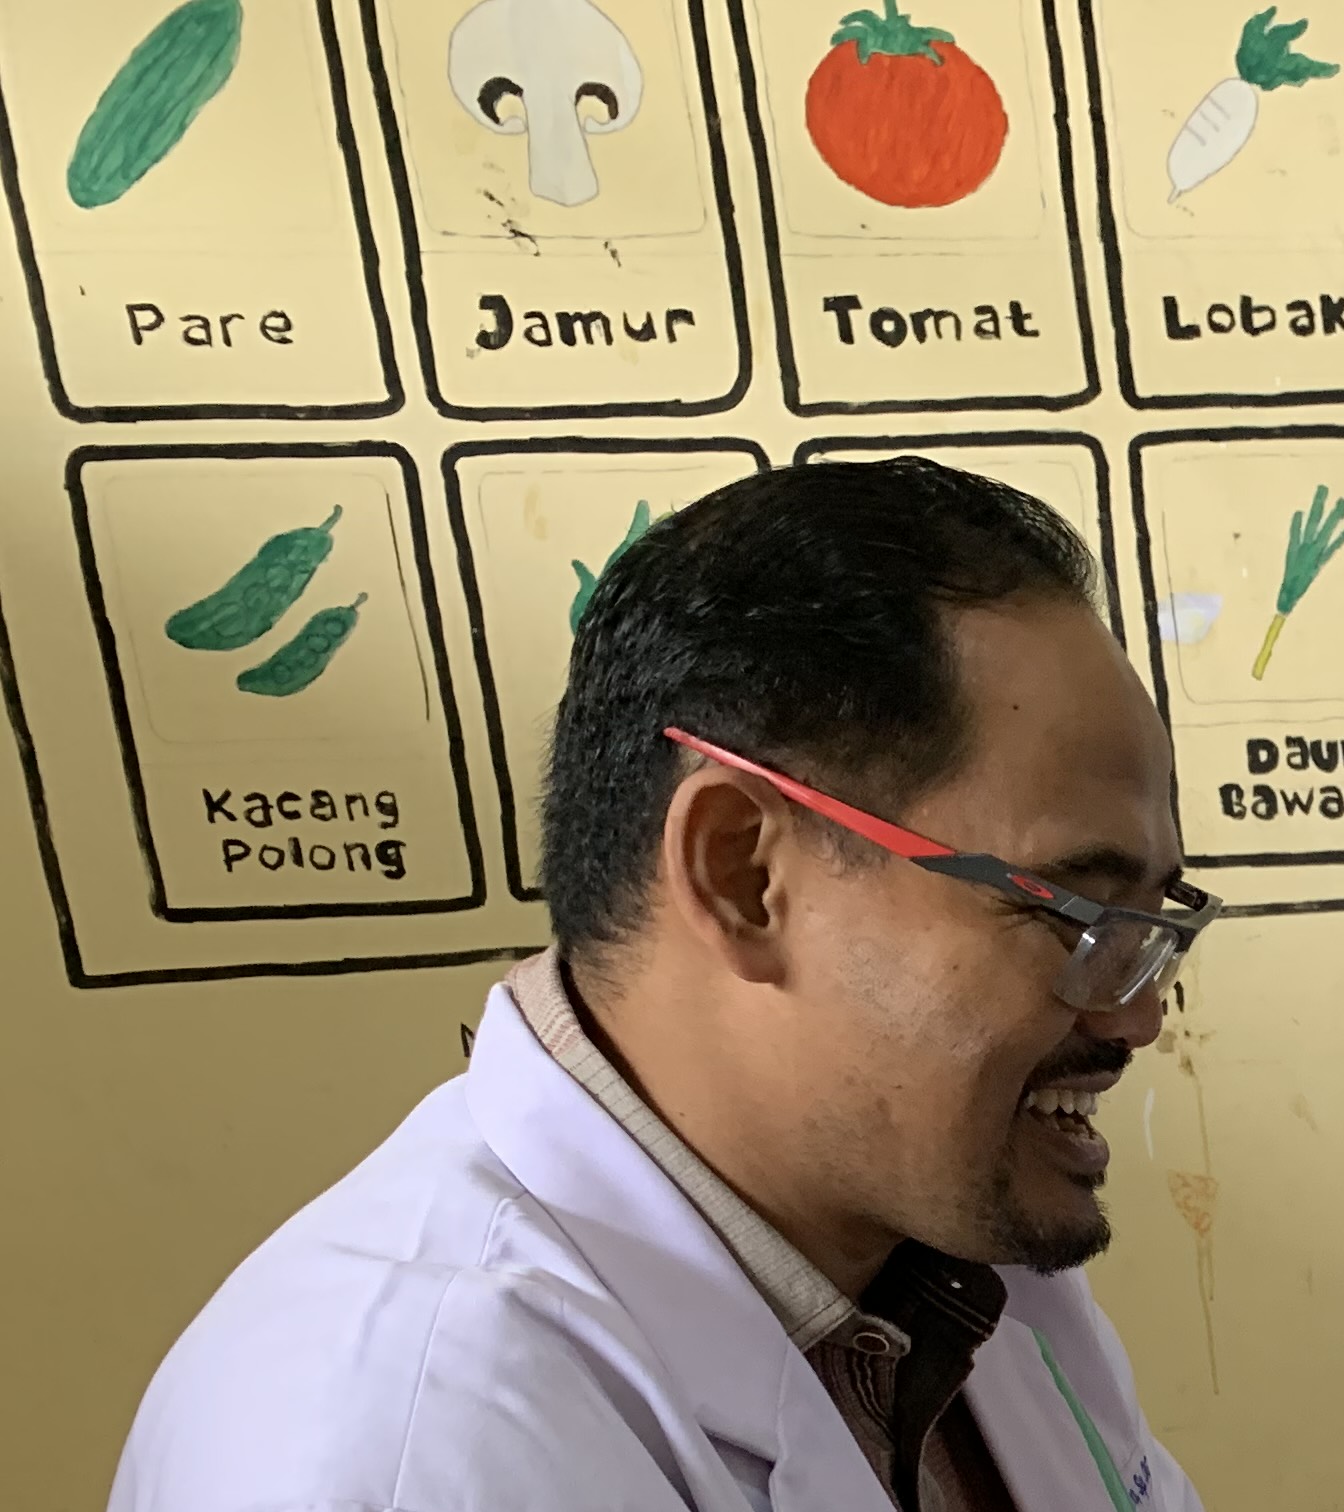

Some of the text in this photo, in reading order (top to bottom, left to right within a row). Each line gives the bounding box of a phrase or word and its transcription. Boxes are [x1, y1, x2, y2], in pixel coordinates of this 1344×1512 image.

[126, 303, 294, 347] Pare
[475, 294, 696, 351] Jamur
[823, 295, 1041, 348] Tomat
[201, 788, 400, 829] Kacang
[221, 836, 408, 881] Polong
